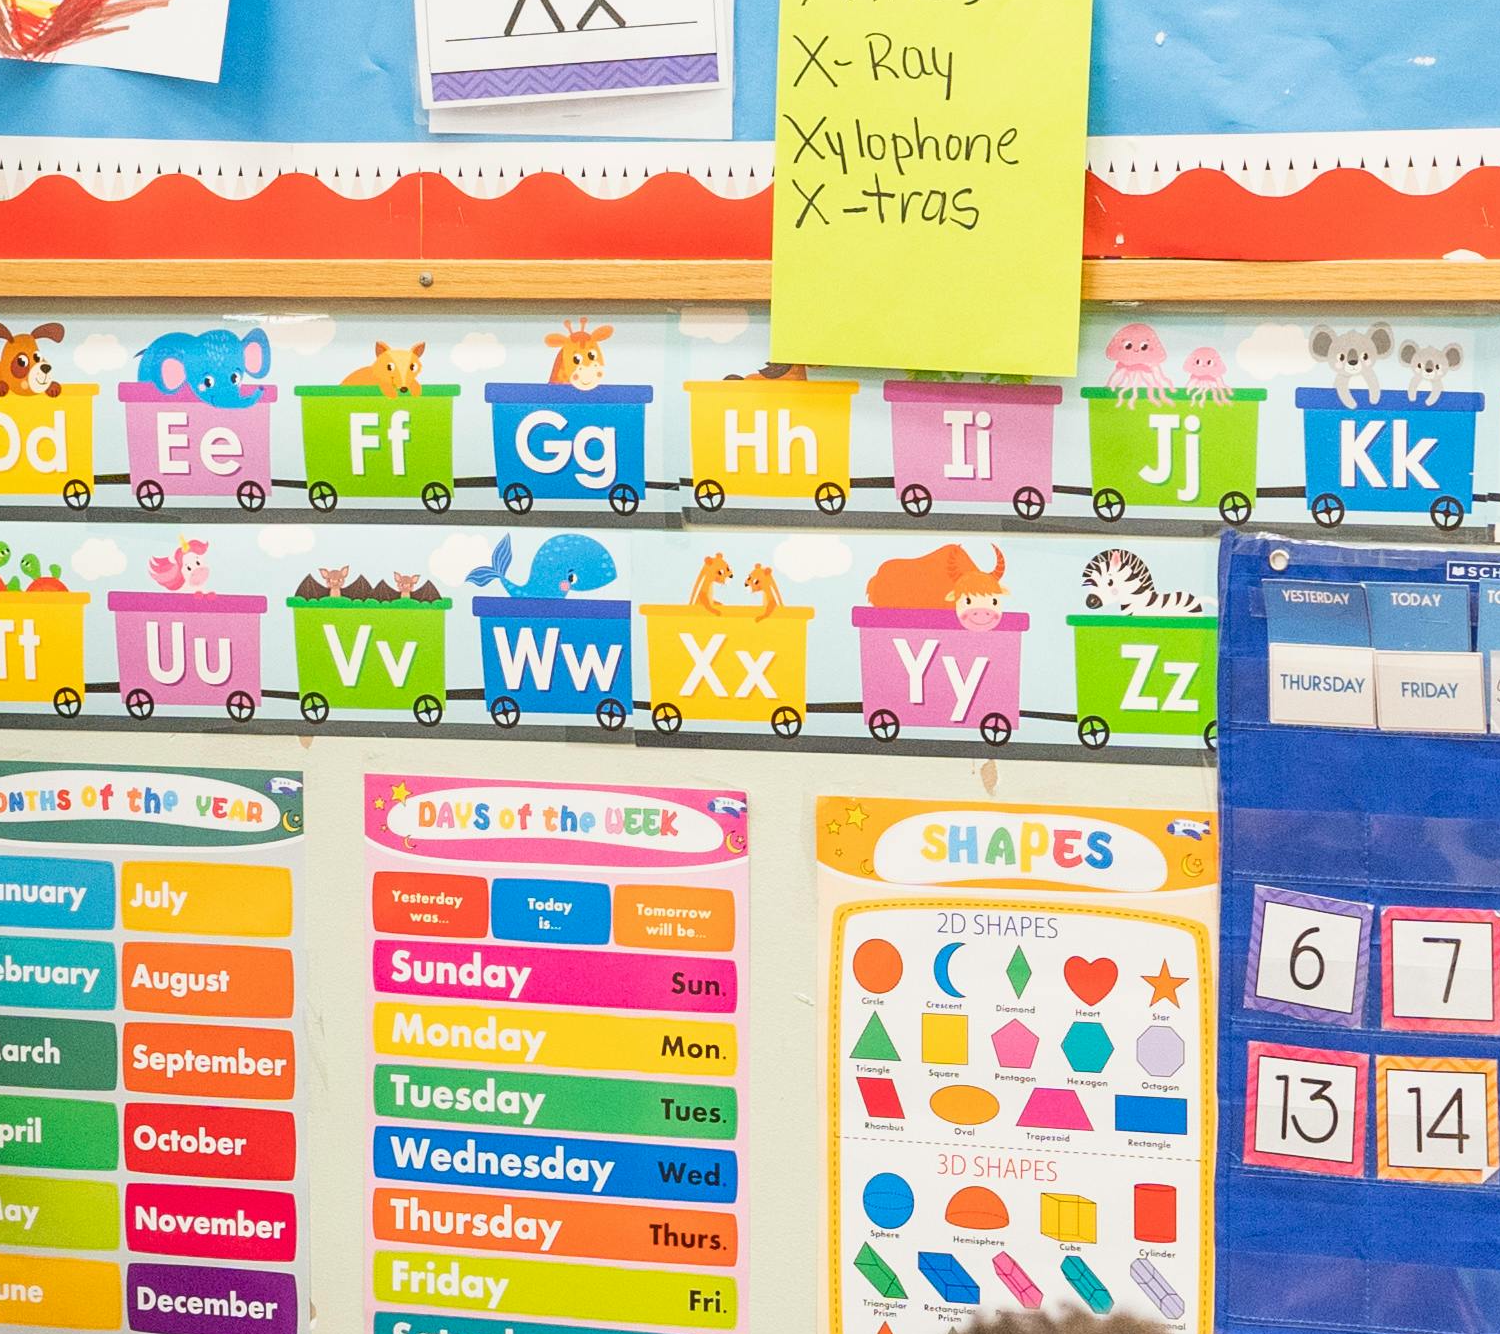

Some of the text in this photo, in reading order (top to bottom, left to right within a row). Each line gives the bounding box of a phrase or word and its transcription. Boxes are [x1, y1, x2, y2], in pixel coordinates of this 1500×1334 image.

[783, 114, 1020, 176] Xylophone
[155, 411, 243, 475] Ee
[349, 412, 410, 476] Ff
[514, 410, 617, 489] Gg
[723, 409, 817, 475] Hh
[942, 409, 991, 480] Ii
[1138, 414, 1200, 502] Jj
[1339, 420, 1439, 490] Kk
[1282, 589, 1350, 606] YESTERDAY
[1391, 592, 1441, 607] TODAY
[144, 621, 232, 686] Uu
[321, 624, 417, 688] Vv
[492, 626, 623, 693] Ww
[677, 633, 777, 698] Xx
[891, 637, 990, 723] Yy
[1120, 645, 1198, 713] Zz
[1280, 674, 1366, 694] THURSDAY
[1401, 682, 1458, 699] FRIDAY
[196, 795, 263, 823] YEAR
[417, 800, 490, 831] DAYS
[605, 807, 680, 837] WEEK
[921, 821, 1114, 874] SHAPES
[129, 882, 187, 916] July
[937, 912, 1059, 940] 2D SHAPES
[131, 964, 229, 998] August
[391, 949, 532, 999] Sunday
[671, 972, 727, 997] Sun.
[861, 996, 885, 1007] Circle
[1075, 1008, 1101, 1019] Heart
[391, 1012, 547, 1062] Monday
[660, 1035, 727, 1061] Mon.
[132, 1045, 287, 1078] September
[390, 1075, 546, 1124] Tuesday
[133, 1124, 247, 1157] October
[390, 1137, 615, 1193] Wednesday
[937, 1153, 1059, 1183] 3D SHAPES
[134, 1206, 286, 1240] November
[390, 1199, 563, 1251] Thursday
[1059, 1242, 1082, 1253] Cube
[391, 1260, 510, 1309] Friday
[136, 1287, 279, 1320] December
